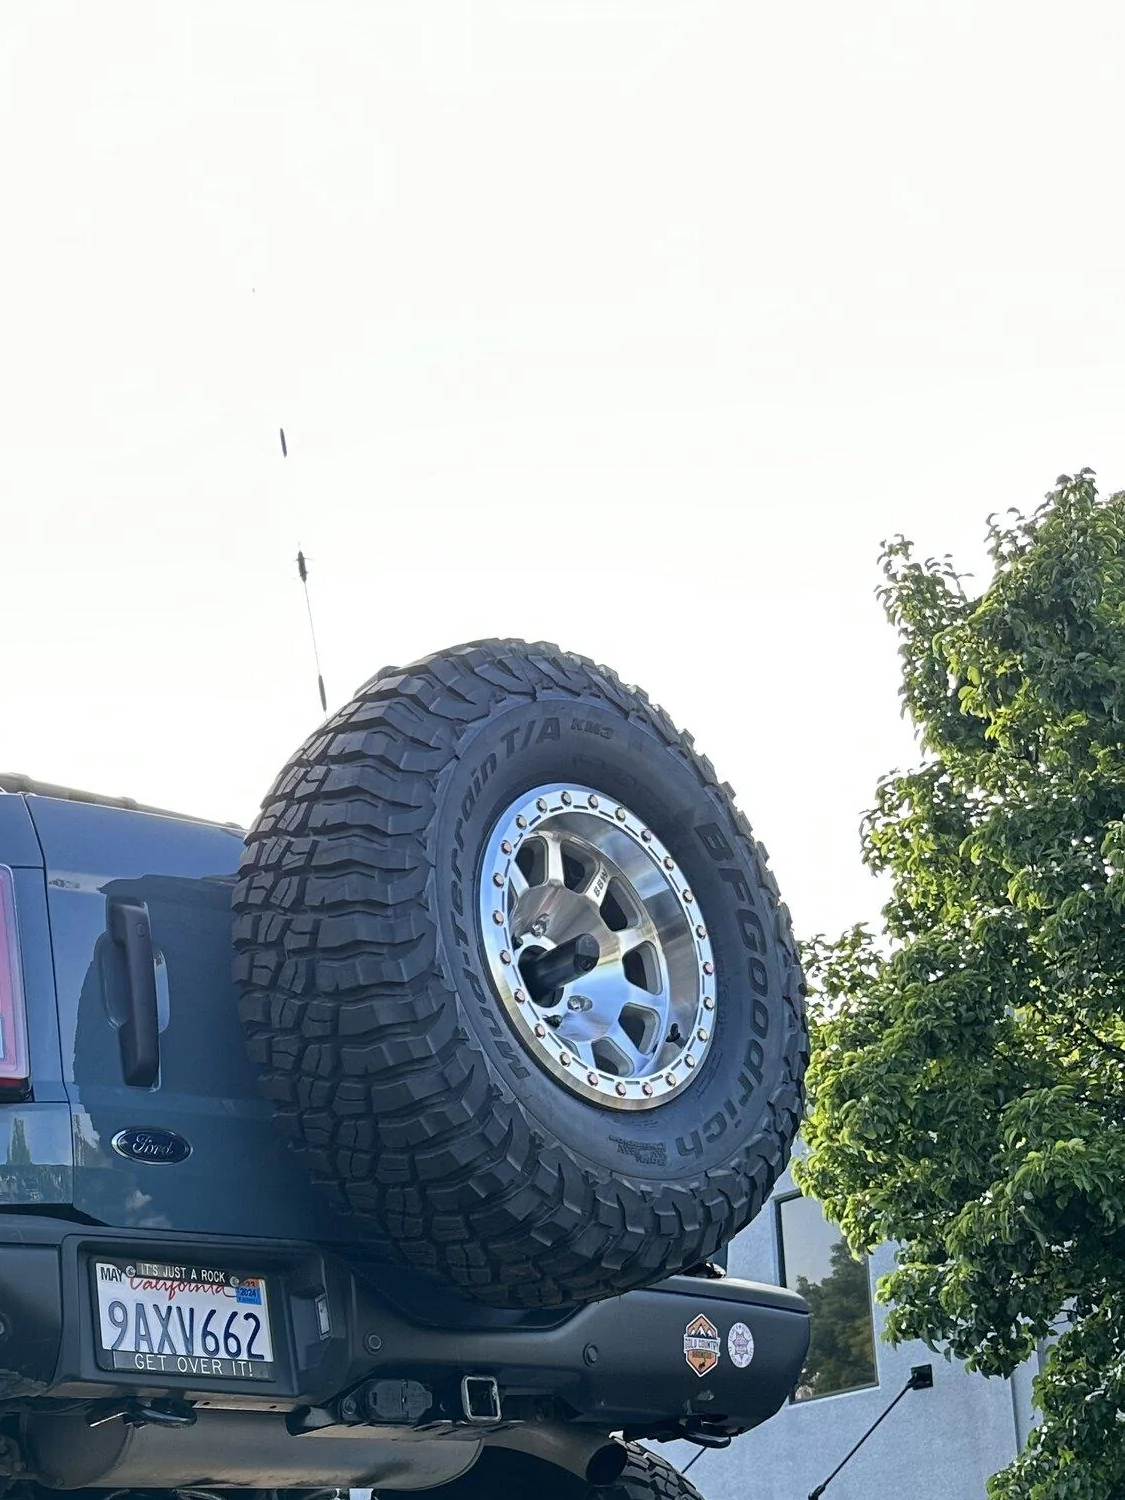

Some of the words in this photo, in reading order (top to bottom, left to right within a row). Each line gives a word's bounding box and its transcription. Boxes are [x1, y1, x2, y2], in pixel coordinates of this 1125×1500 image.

[500, 716, 561, 759] T/A
[132, 1133, 174, 1155] Ford
[100, 1266, 123, 1282] MAY
[141, 1263, 159, 1276] IT'S
[162, 1266, 187, 1279] JUST
[190, 1269, 198, 1280] A
[201, 1270, 225, 1283] ROCK
[129, 1277, 237, 1300] California
[238, 1287, 257, 1298] 2024
[107, 1300, 265, 1361] 9AXV662
[134, 1353, 167, 1371] GET
[178, 1356, 223, 1375] OVER
[232, 1361, 254, 1377] IT!
